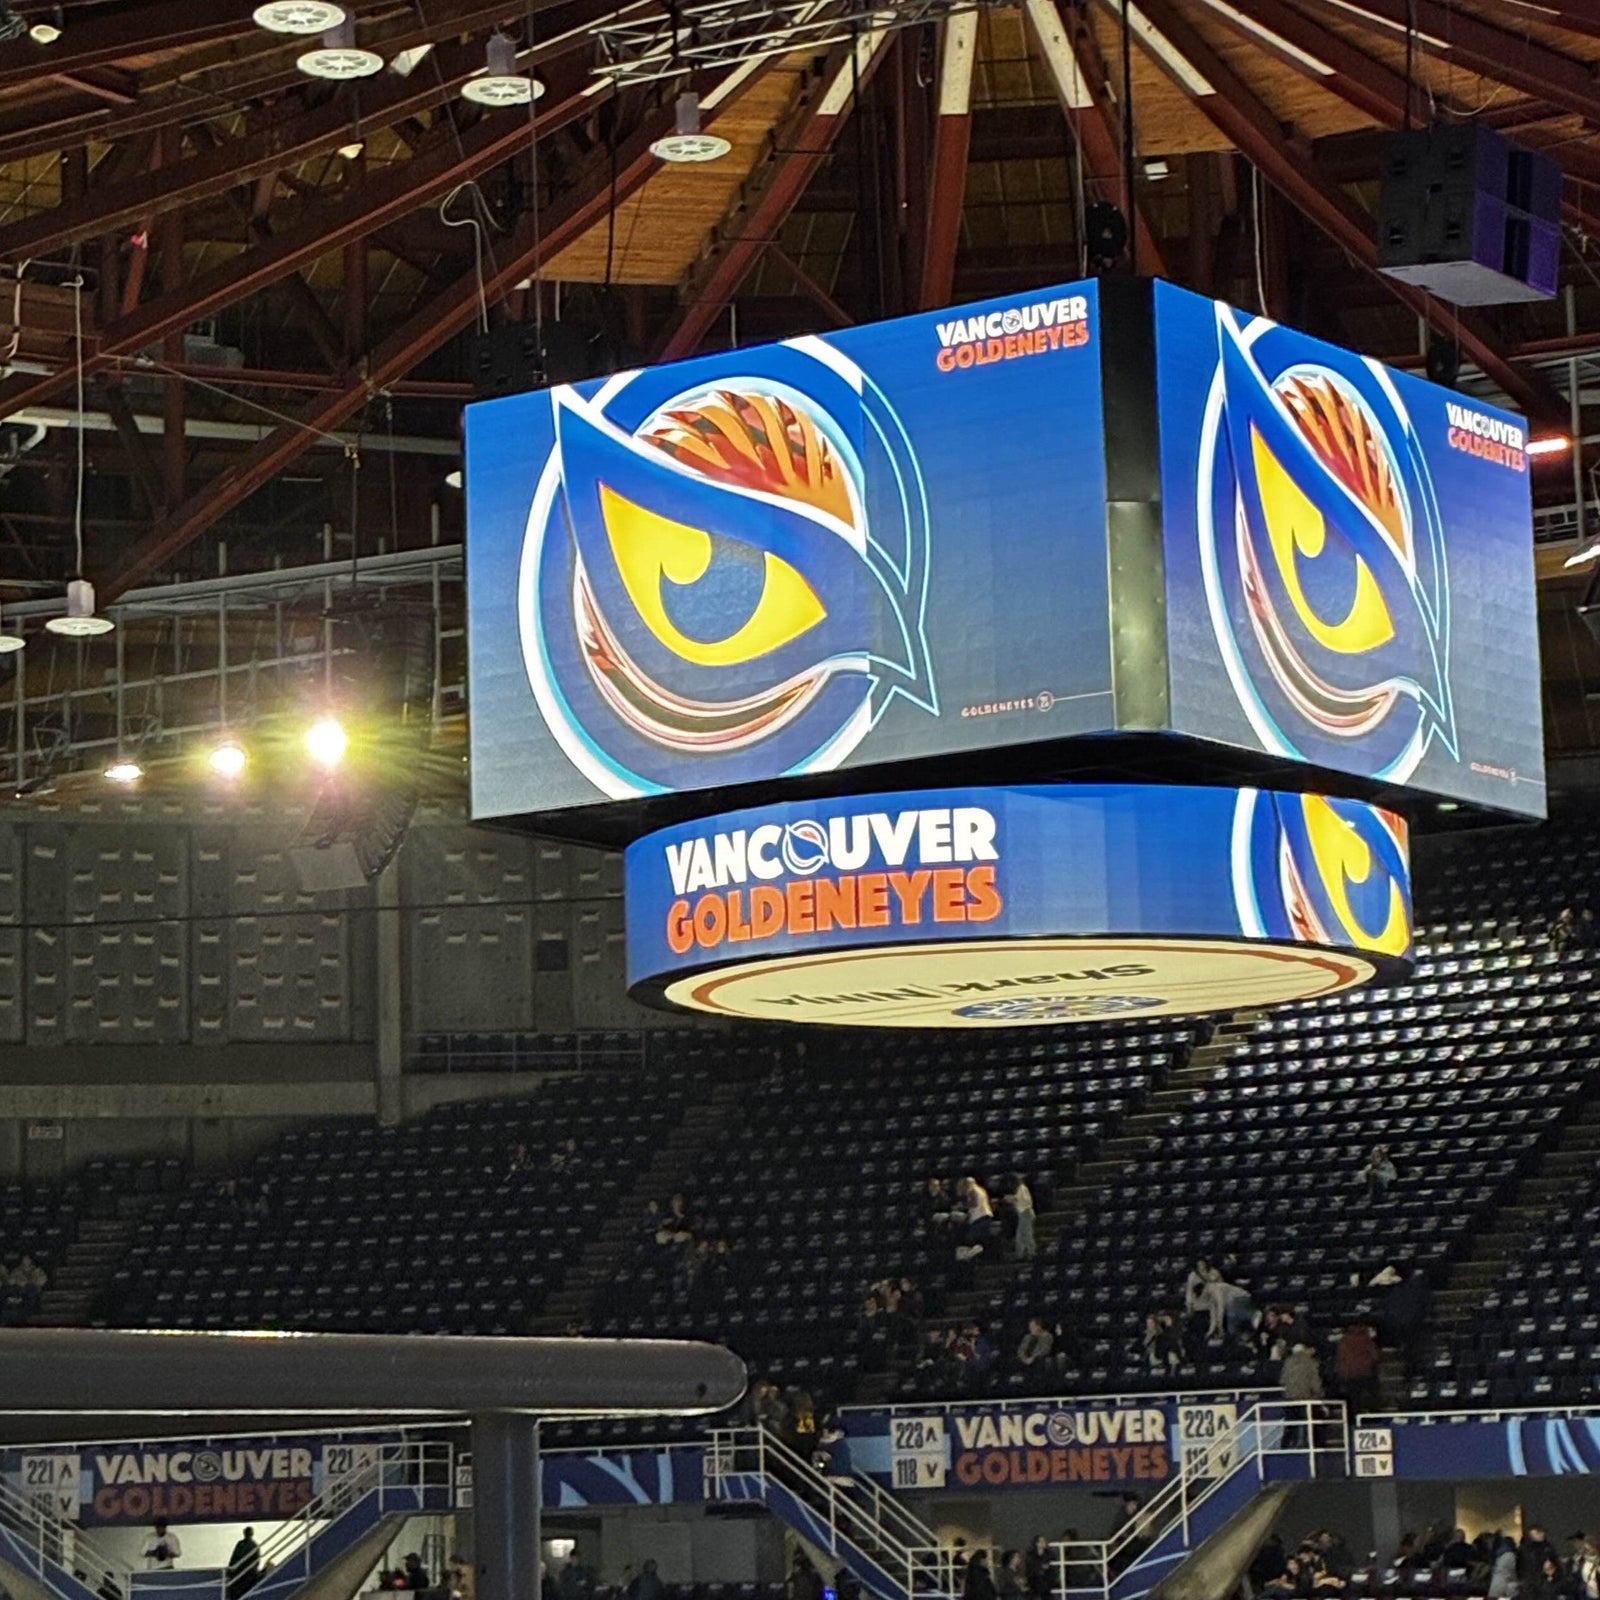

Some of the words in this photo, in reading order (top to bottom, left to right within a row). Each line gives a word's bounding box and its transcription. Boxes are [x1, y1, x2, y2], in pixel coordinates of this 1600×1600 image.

[936, 296, 1088, 347] VANCOUVER
[936, 321, 1089, 372] GOLDENEYES
[1446, 402, 1523, 451] VANCOUVER
[961, 698, 1034, 718] GOLDENEYES
[665, 807, 999, 895] VANCOUVER
[667, 866, 1003, 953] GOLDENEYES
[941, 964, 1156, 992] Shark
[756, 986, 941, 1008] NINJA
[896, 1422, 924, 1449] 223
[955, 1409, 1167, 1449] VANCOUVER
[1184, 1410, 1215, 1438] 223
[27, 1458, 54, 1485] 221
[96, 1448, 313, 1484] VANCOUVER
[328, 1448, 354, 1474] 221
[897, 1458, 918, 1486] 118
[956, 1446, 1169, 1486] GOLDENEYES
[94, 1480, 316, 1519] GOLDENEYES
